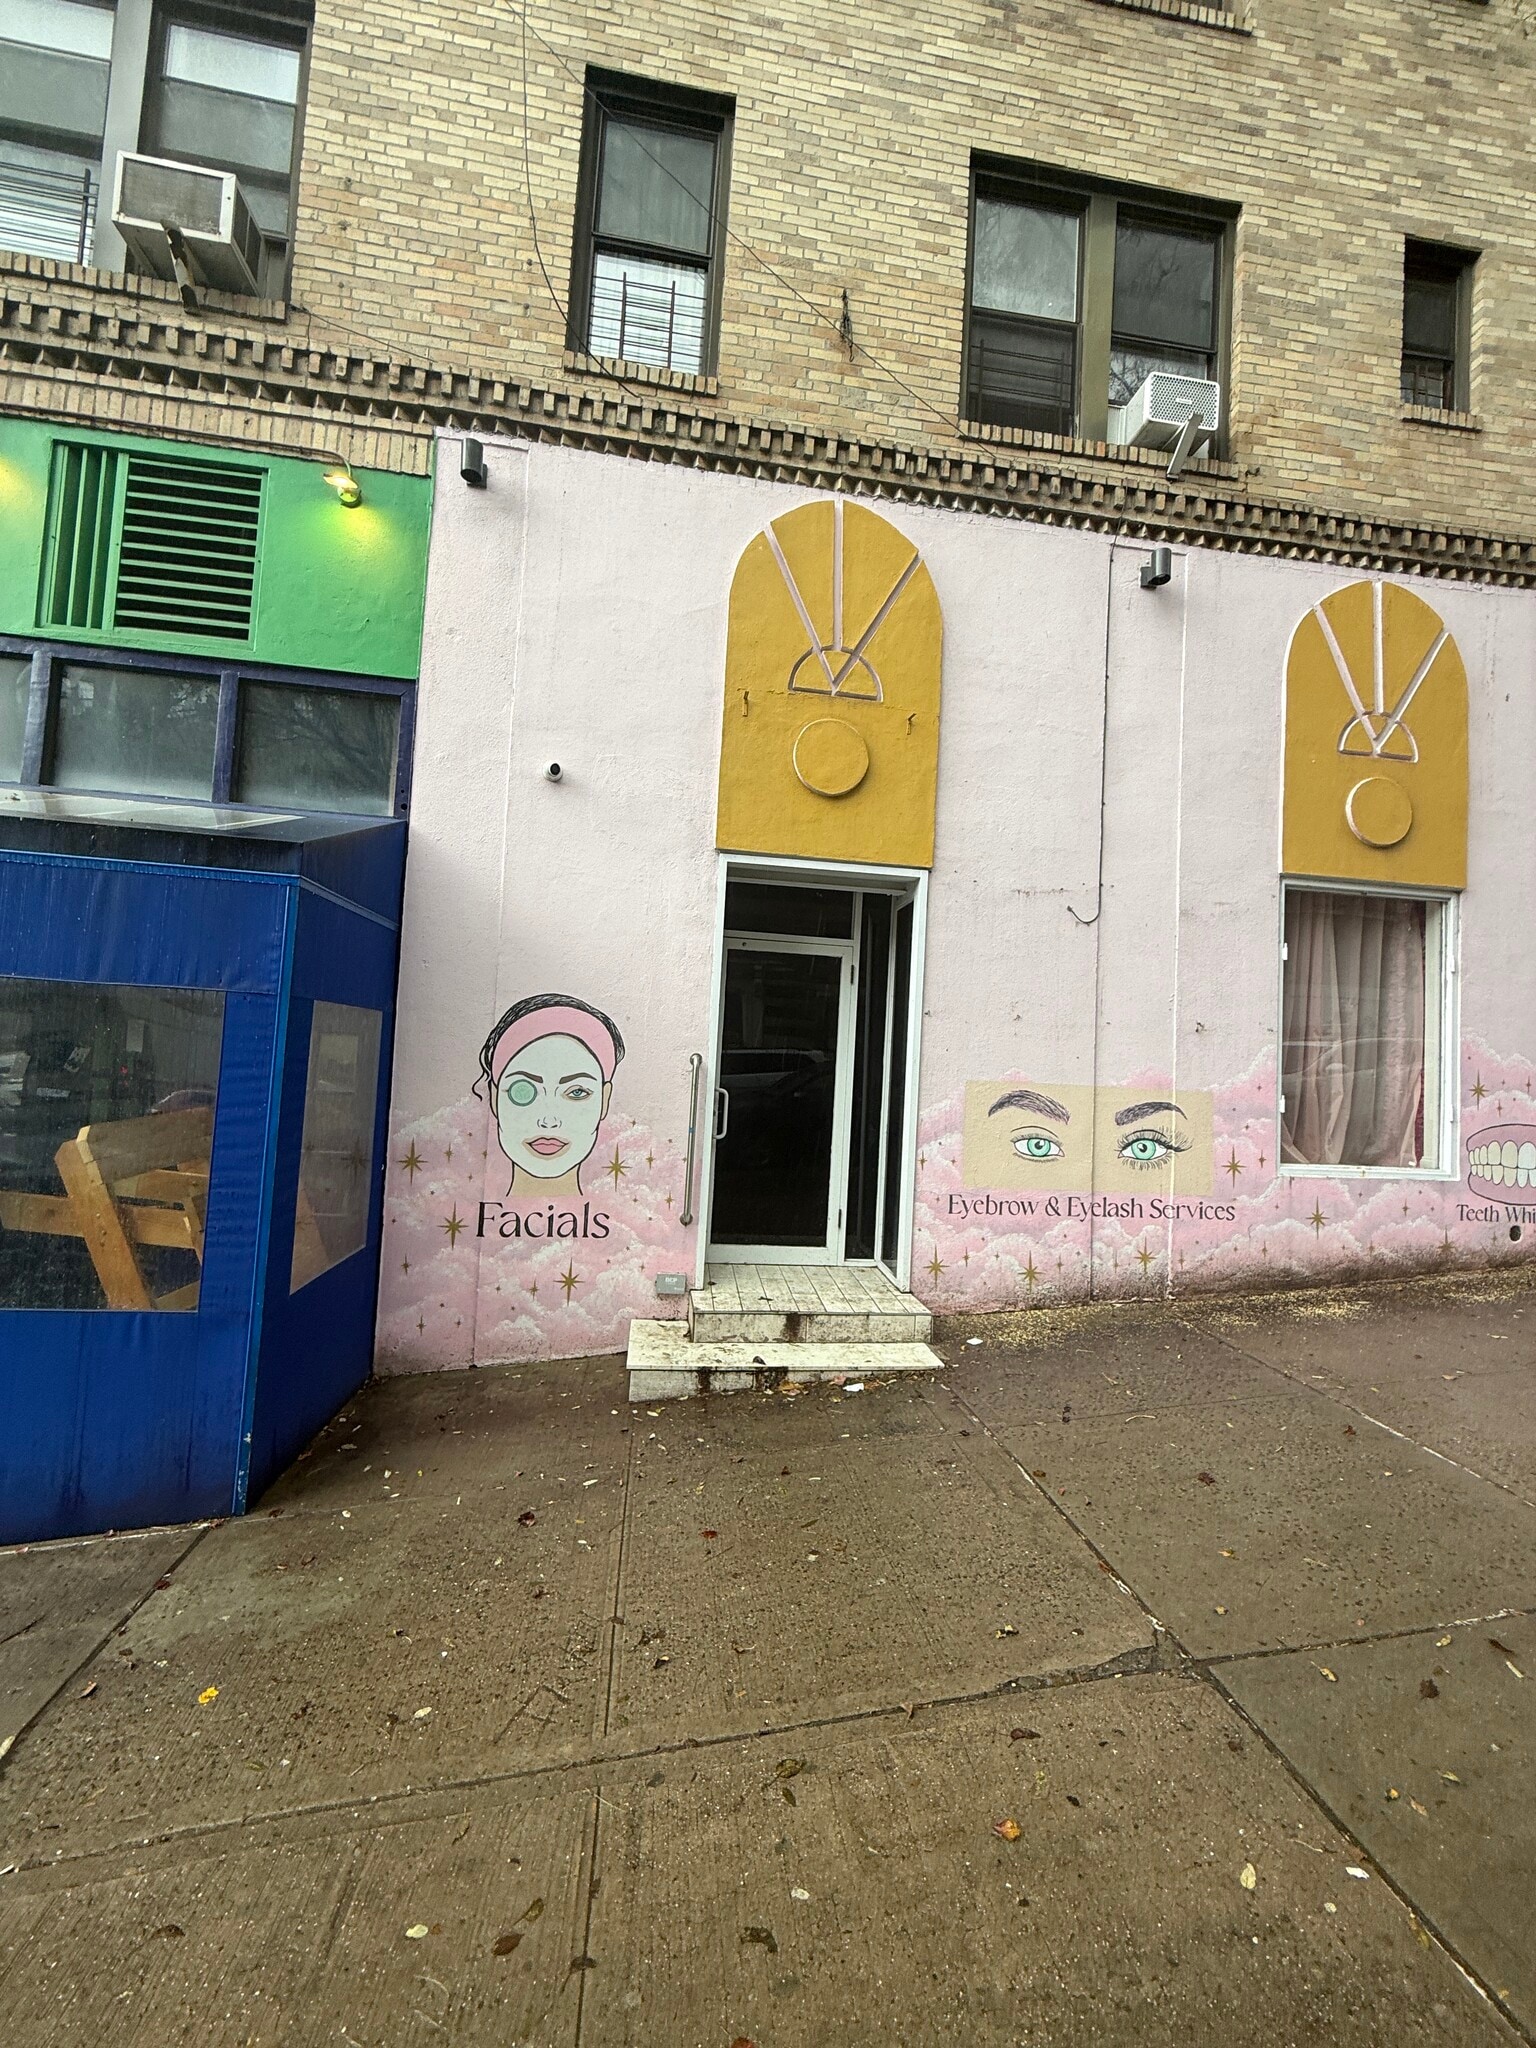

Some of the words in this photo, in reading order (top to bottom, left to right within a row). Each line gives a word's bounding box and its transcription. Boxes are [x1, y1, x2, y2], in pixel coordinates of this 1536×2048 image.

[476, 1201, 610, 1238] Facials
[948, 1194, 1038, 1218] Eyebrow
[1045, 1196, 1061, 1217] &
[1067, 1196, 1143, 1222] Eyelash
[1149, 1199, 1235, 1222] Services
[1456, 1204, 1499, 1223] Teeth
